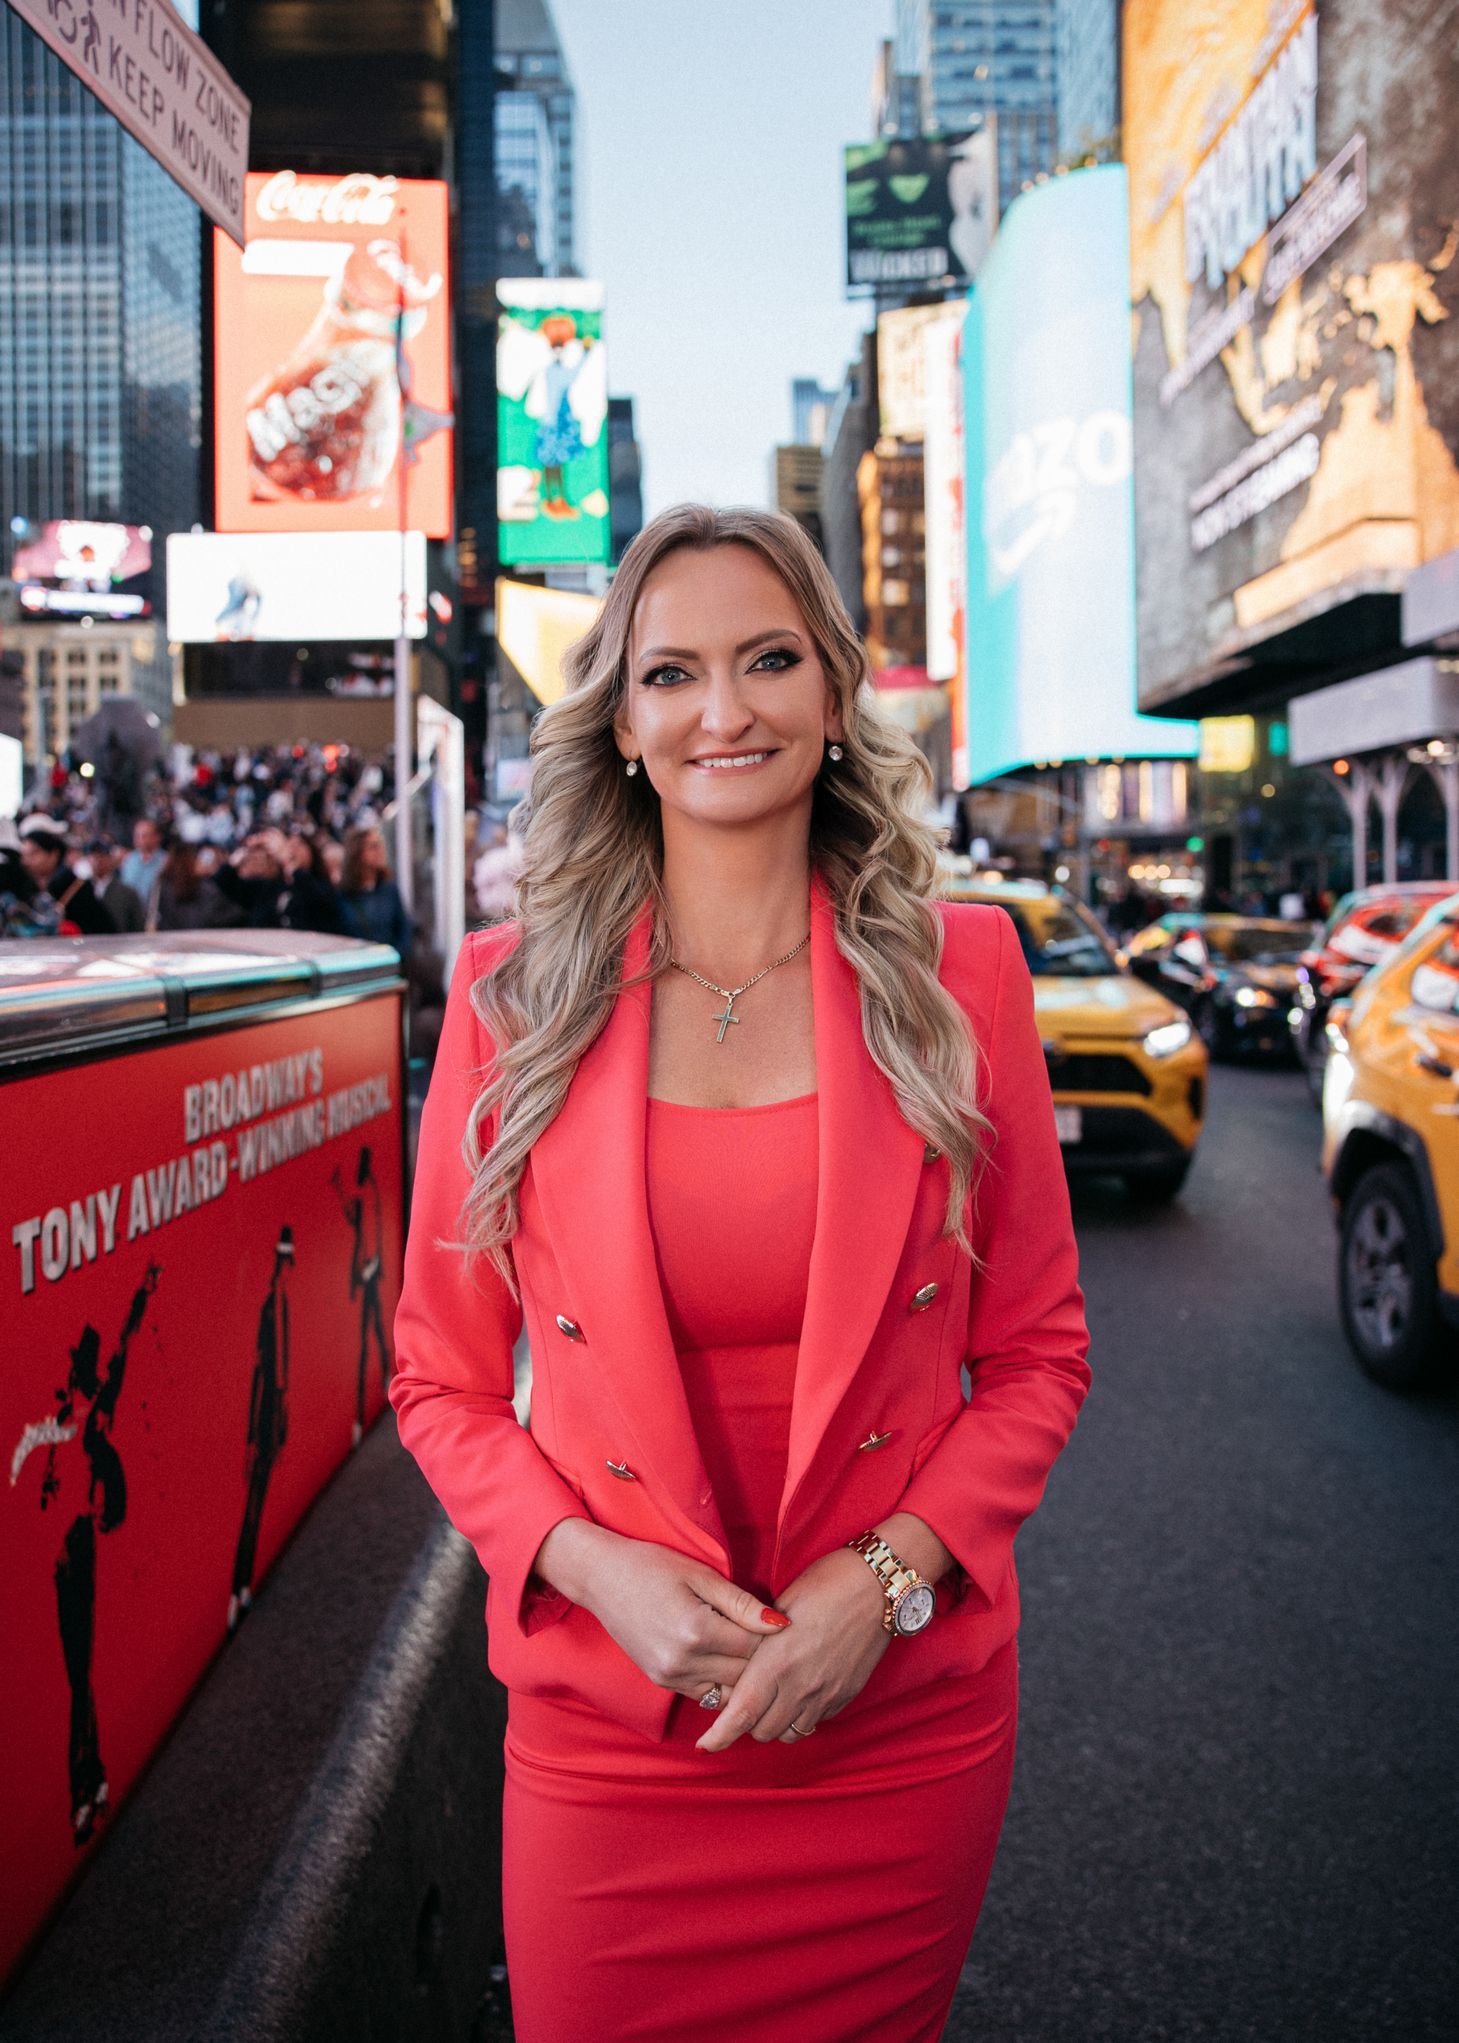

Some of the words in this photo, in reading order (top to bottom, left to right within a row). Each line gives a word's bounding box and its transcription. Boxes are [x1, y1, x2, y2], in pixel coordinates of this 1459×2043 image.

[109, 34, 165, 127] KEEP
[172, 107, 240, 216] MOVING
[134, 0, 190, 93] FLOW
[196, 68, 240, 154] ZONE
[11, 1183, 122, 1295] TONY
